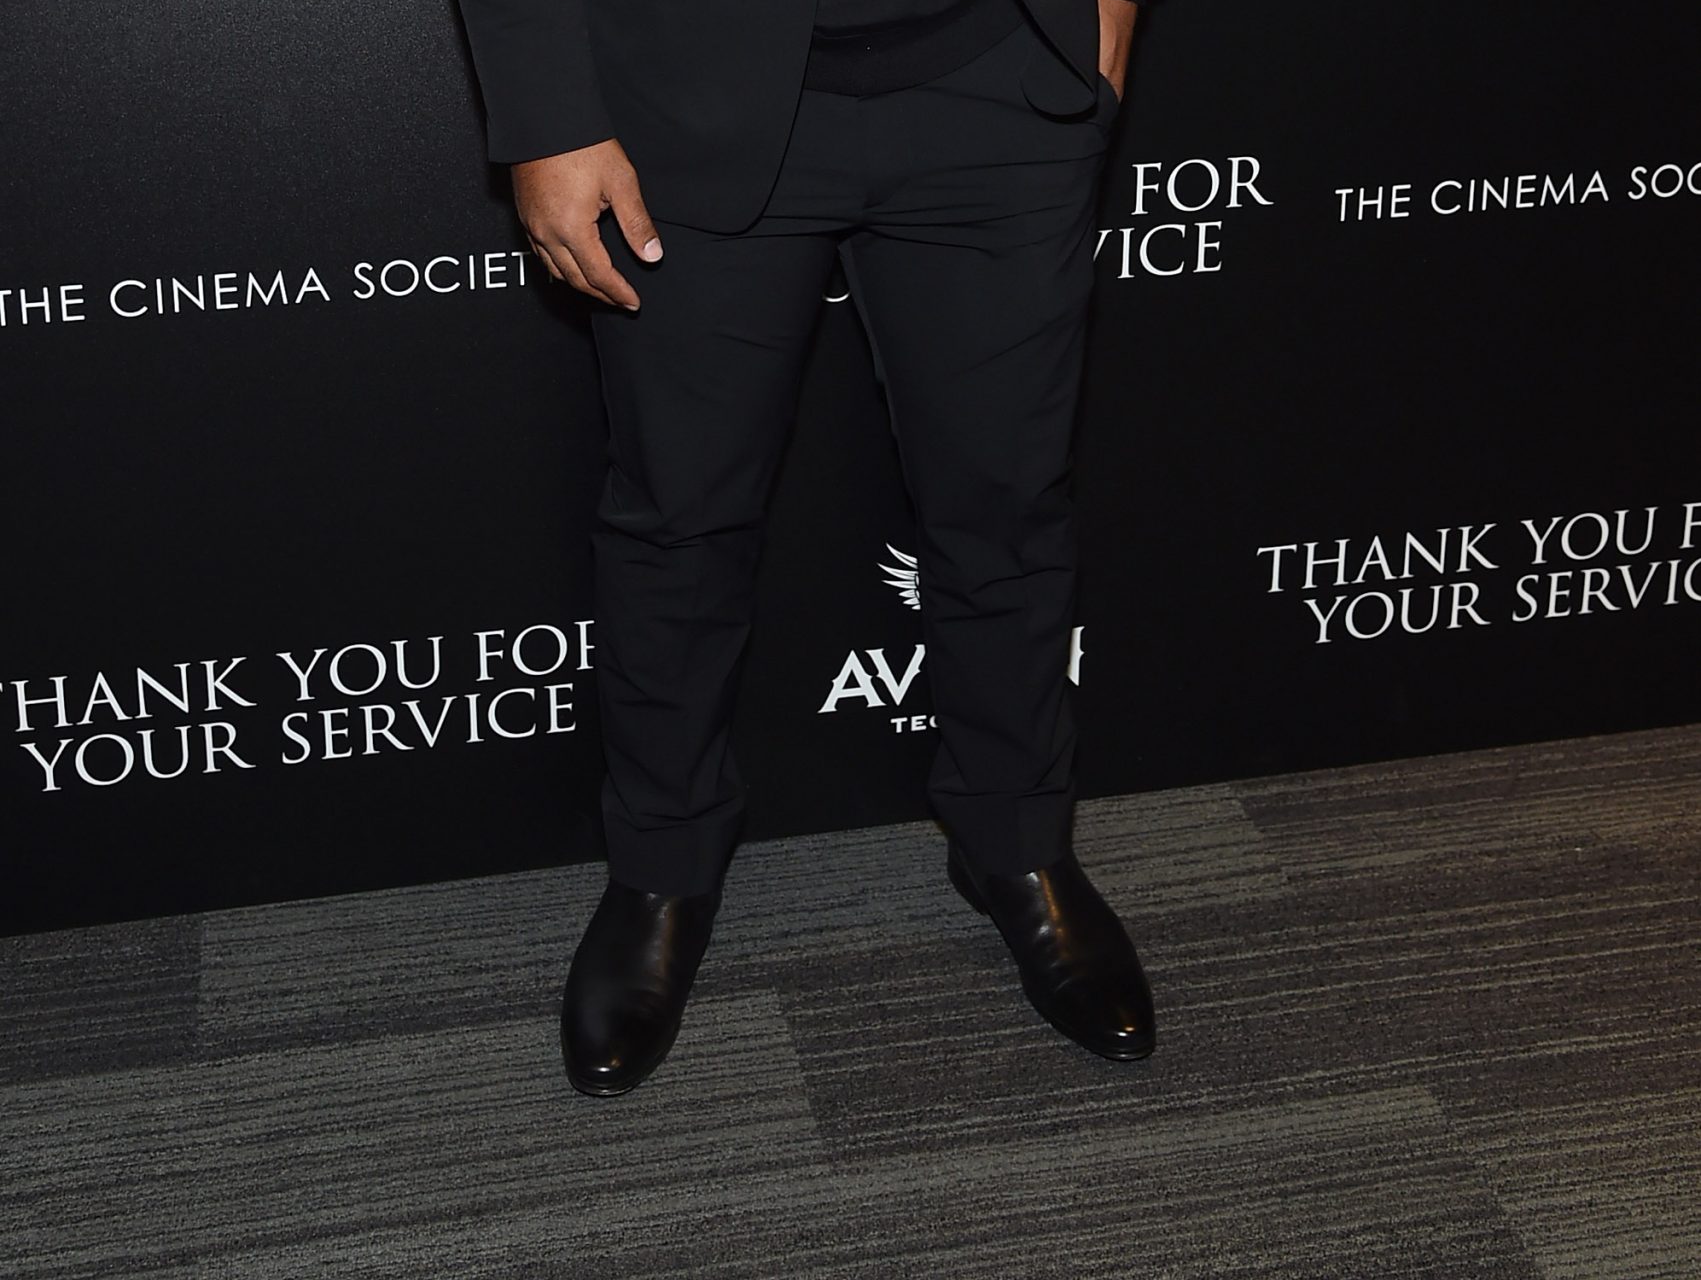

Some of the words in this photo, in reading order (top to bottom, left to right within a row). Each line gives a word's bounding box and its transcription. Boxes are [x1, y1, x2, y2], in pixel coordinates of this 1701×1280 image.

[1131, 156, 1274, 216] FOR
[1334, 183, 1412, 222] THE
[1430, 170, 1609, 215] CINEMA
[0, 284, 86, 327] THE
[109, 267, 331, 318] CINEMA
[1256, 523, 1499, 593] THANK
[1520, 506, 1658, 565] YOU
[1303, 582, 1491, 644] YOUR
[0, 656, 257, 732] HANK
[275, 635, 444, 701] YOU
[19, 721, 256, 792] YOUR
[282, 682, 576, 764] SERVICE
